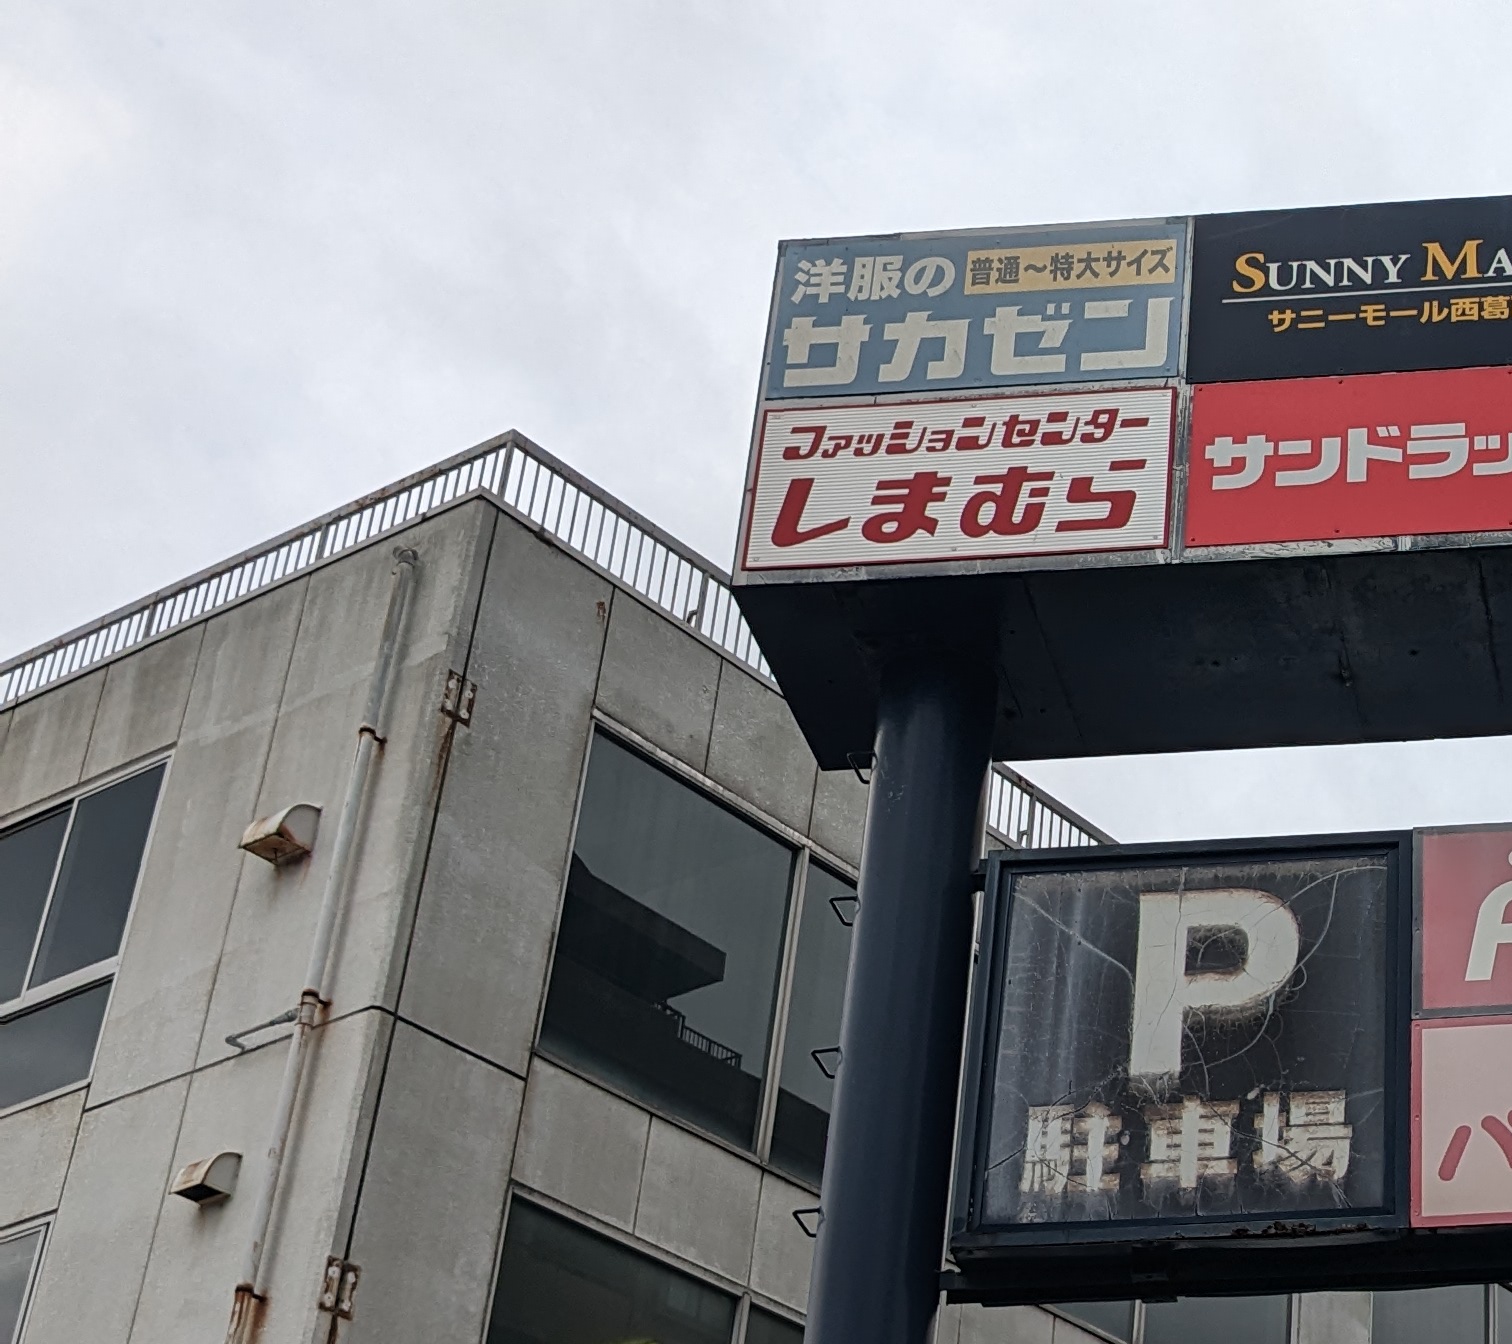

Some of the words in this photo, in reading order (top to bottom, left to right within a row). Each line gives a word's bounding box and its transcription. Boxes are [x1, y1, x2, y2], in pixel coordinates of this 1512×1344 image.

[791, 255, 955, 304] 洋服の
[1232, 252, 1410, 294] SUNNY
[782, 296, 1175, 389] サカゼン
[782, 408, 1150, 461] ファッションセンター
[770, 458, 1148, 547] しまむら
[1130, 887, 1299, 1077] P
[1019, 1090, 1352, 1195] 駐車場
